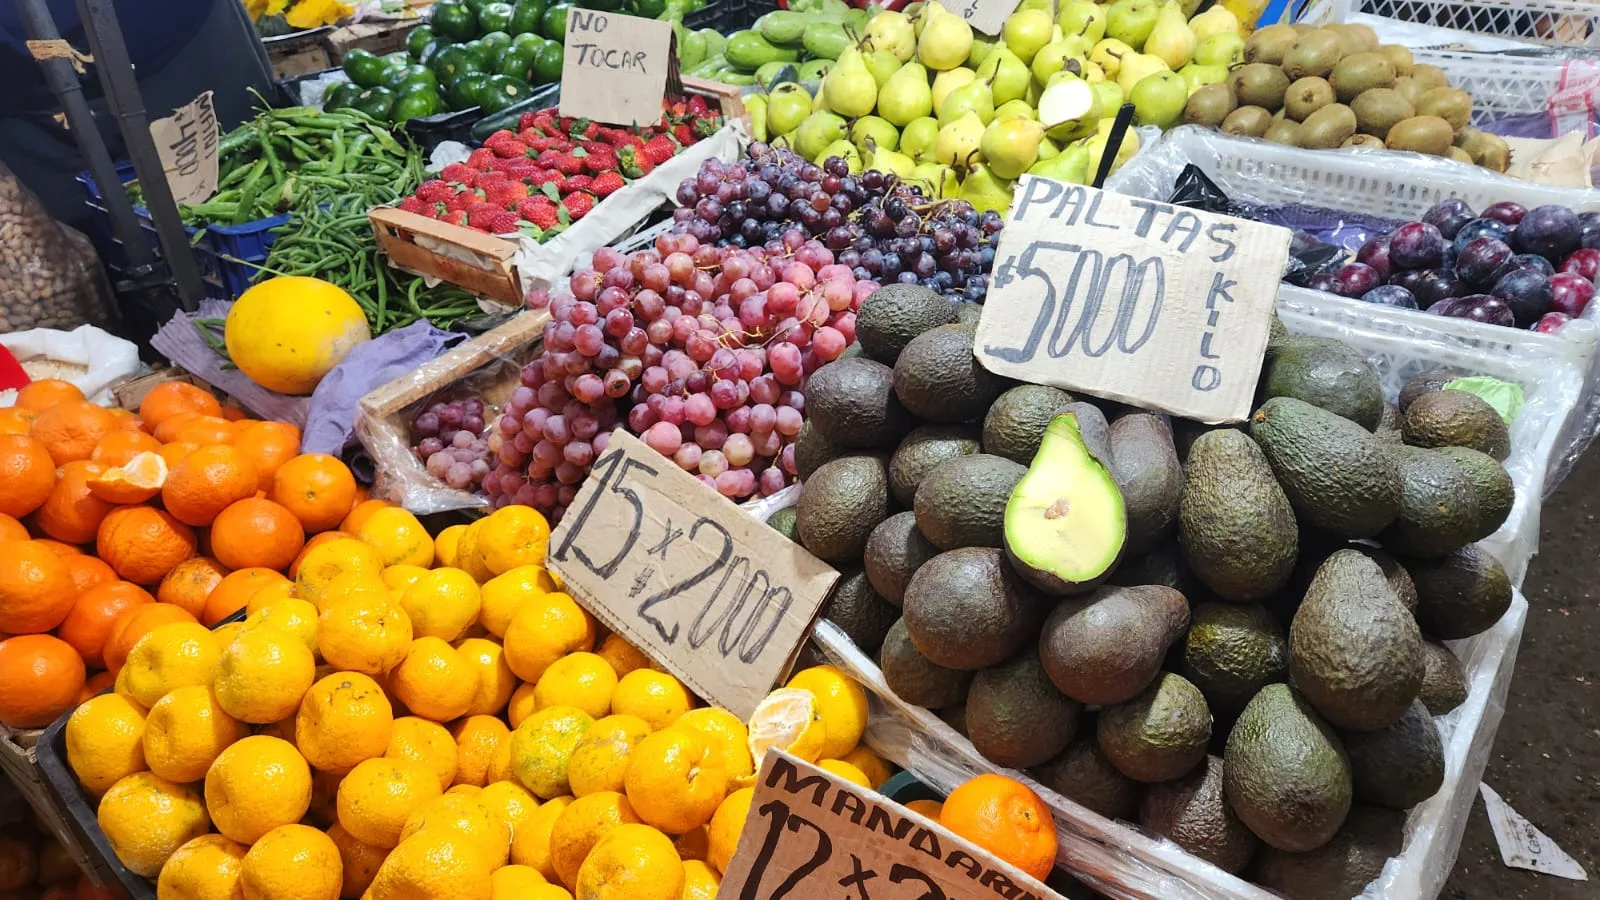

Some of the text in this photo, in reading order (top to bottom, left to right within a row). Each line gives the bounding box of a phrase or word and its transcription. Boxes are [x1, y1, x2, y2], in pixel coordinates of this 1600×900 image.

[570, 11, 608, 33] NO
[572, 43, 647, 75] TOCAR
[1013, 177, 1238, 262] PALTAS
[984, 240, 1165, 364] $5000
[1191, 271, 1238, 391] KILO
[553, 448, 658, 580] 15
